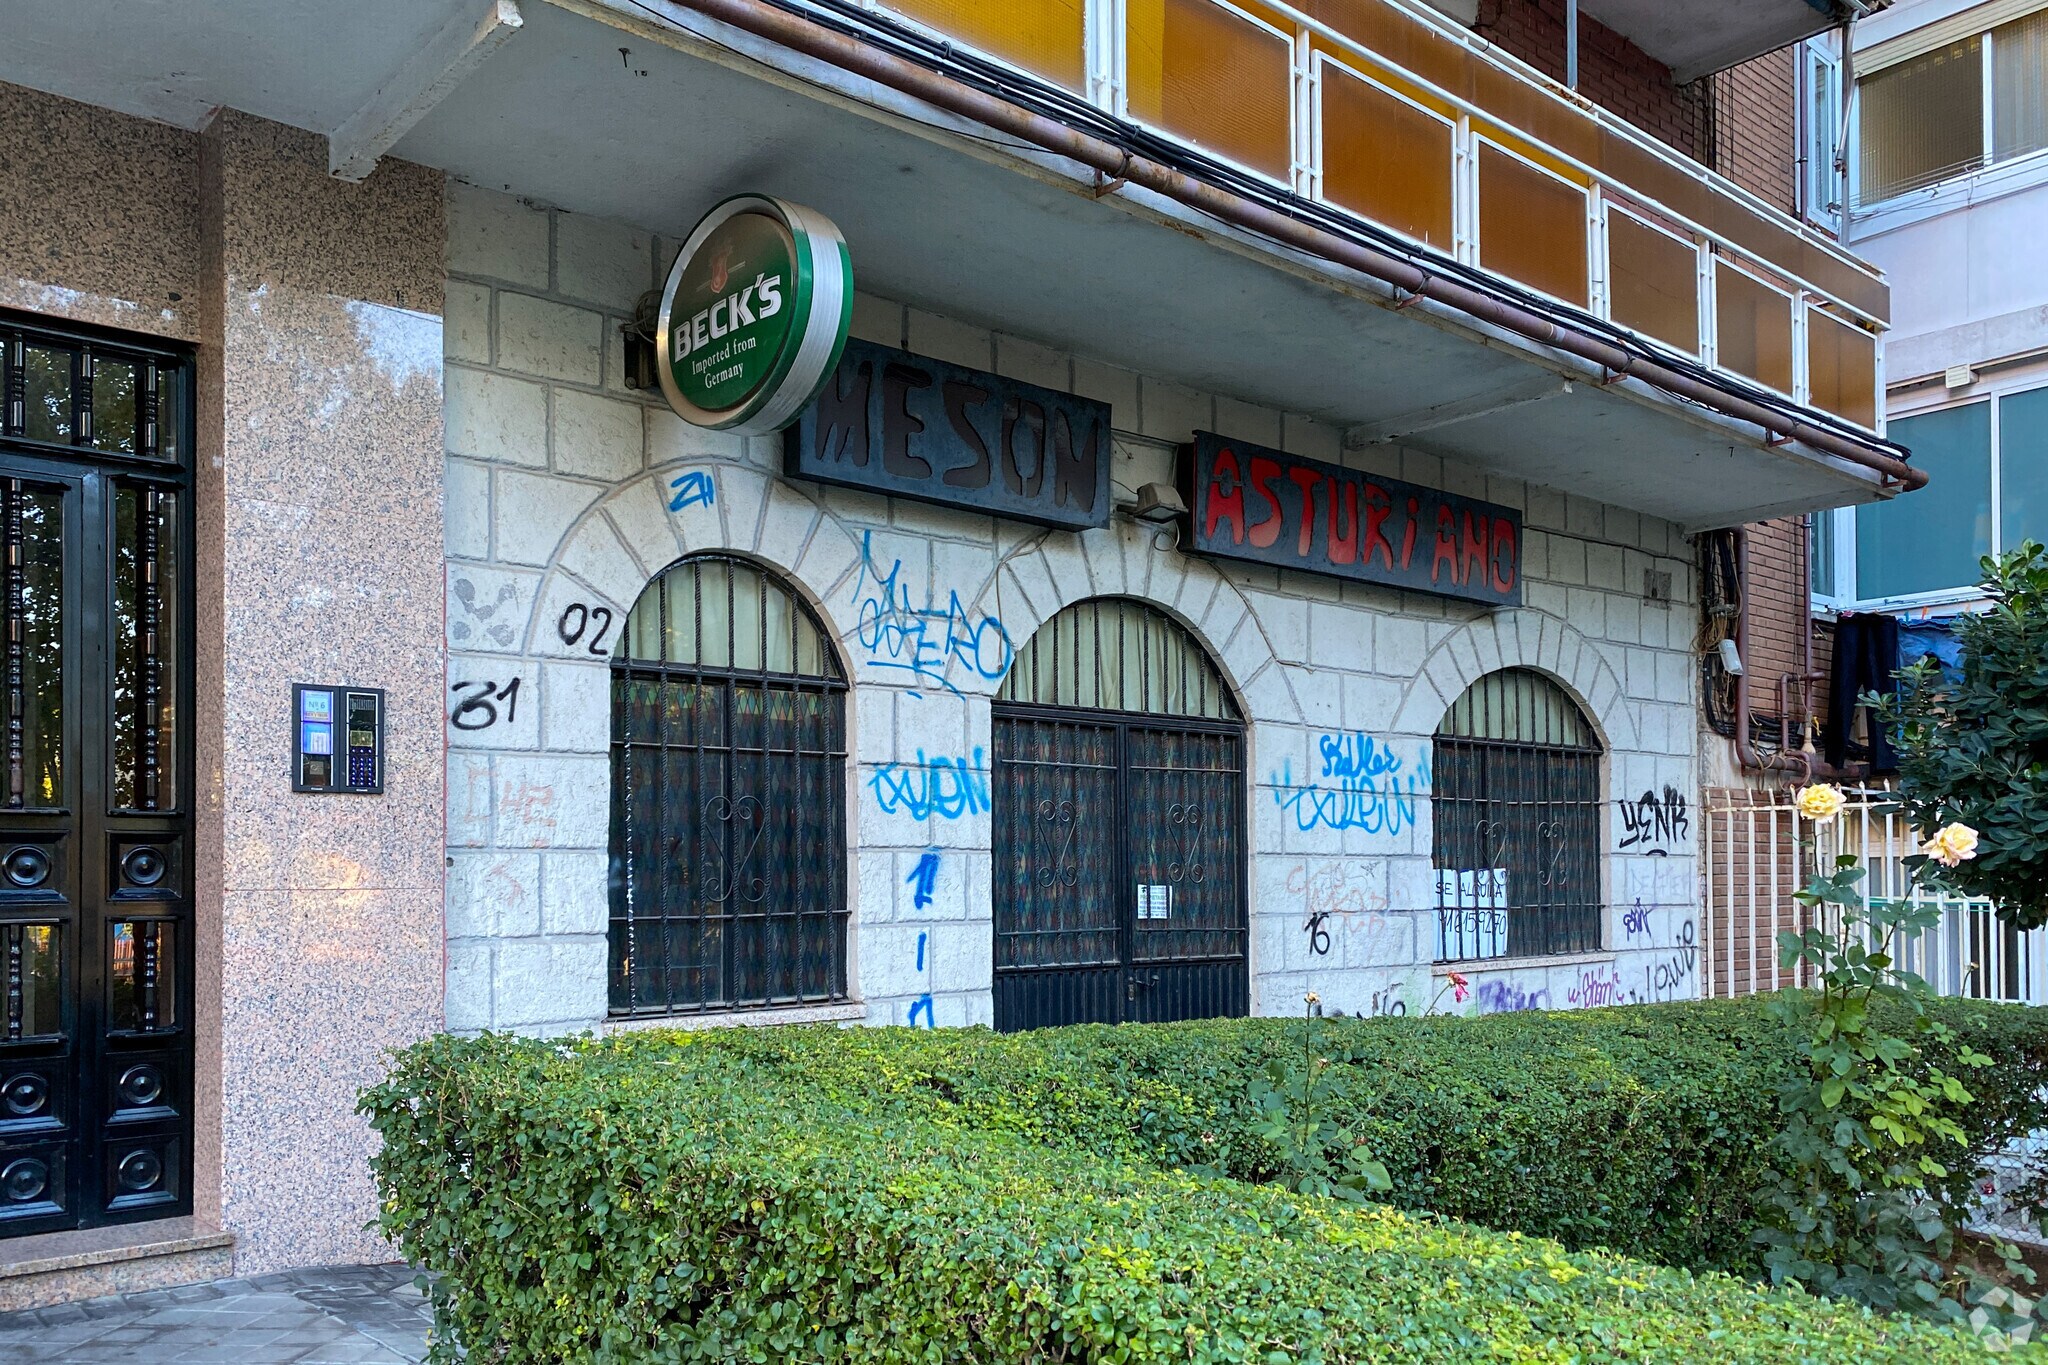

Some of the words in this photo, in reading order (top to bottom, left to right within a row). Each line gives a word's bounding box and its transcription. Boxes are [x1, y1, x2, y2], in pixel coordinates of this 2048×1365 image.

[674, 273, 782, 363] BECK'S
[692, 342, 730, 375] Imported
[733, 337, 757, 355] from
[704, 362, 744, 389] Germany
[1435, 881, 1453, 896] SE
